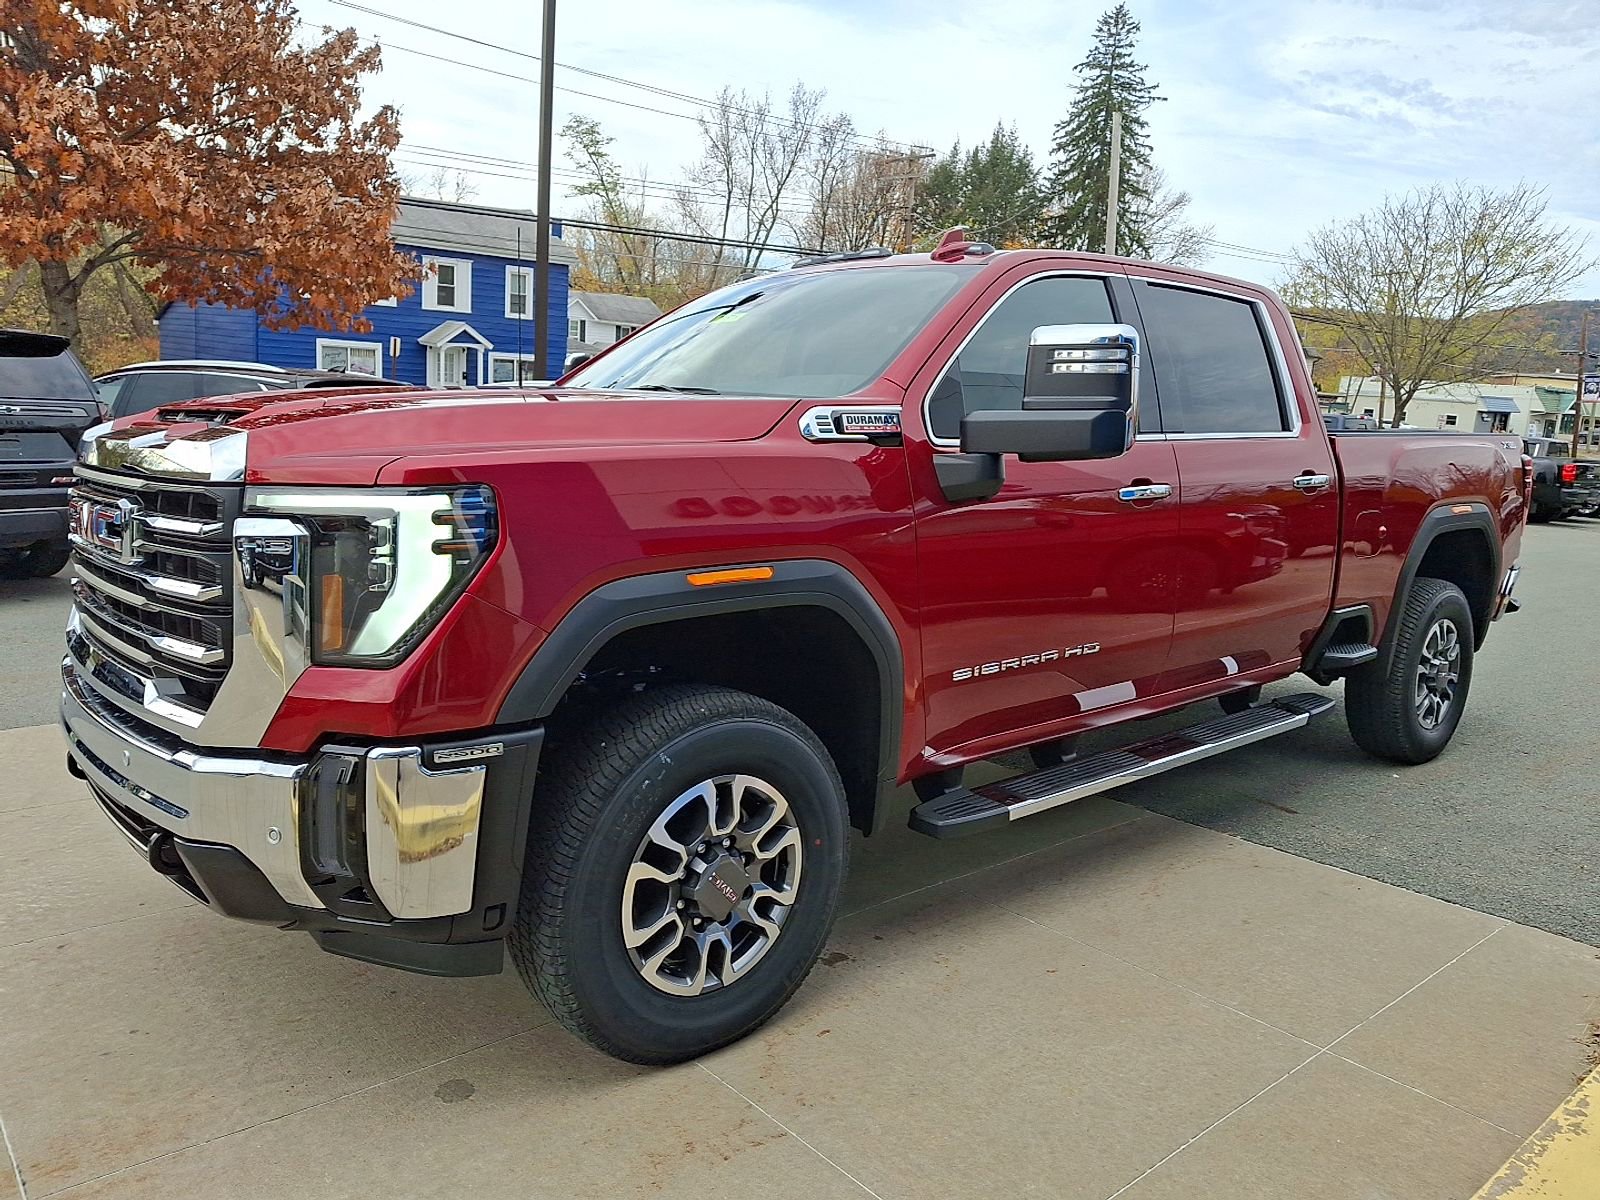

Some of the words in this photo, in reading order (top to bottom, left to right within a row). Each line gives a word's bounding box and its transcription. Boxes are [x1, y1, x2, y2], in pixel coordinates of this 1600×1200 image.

[846, 415, 896, 426] DURAMAX
[952, 649, 1059, 682] SIERRA
[1064, 642, 1101, 659] HD
